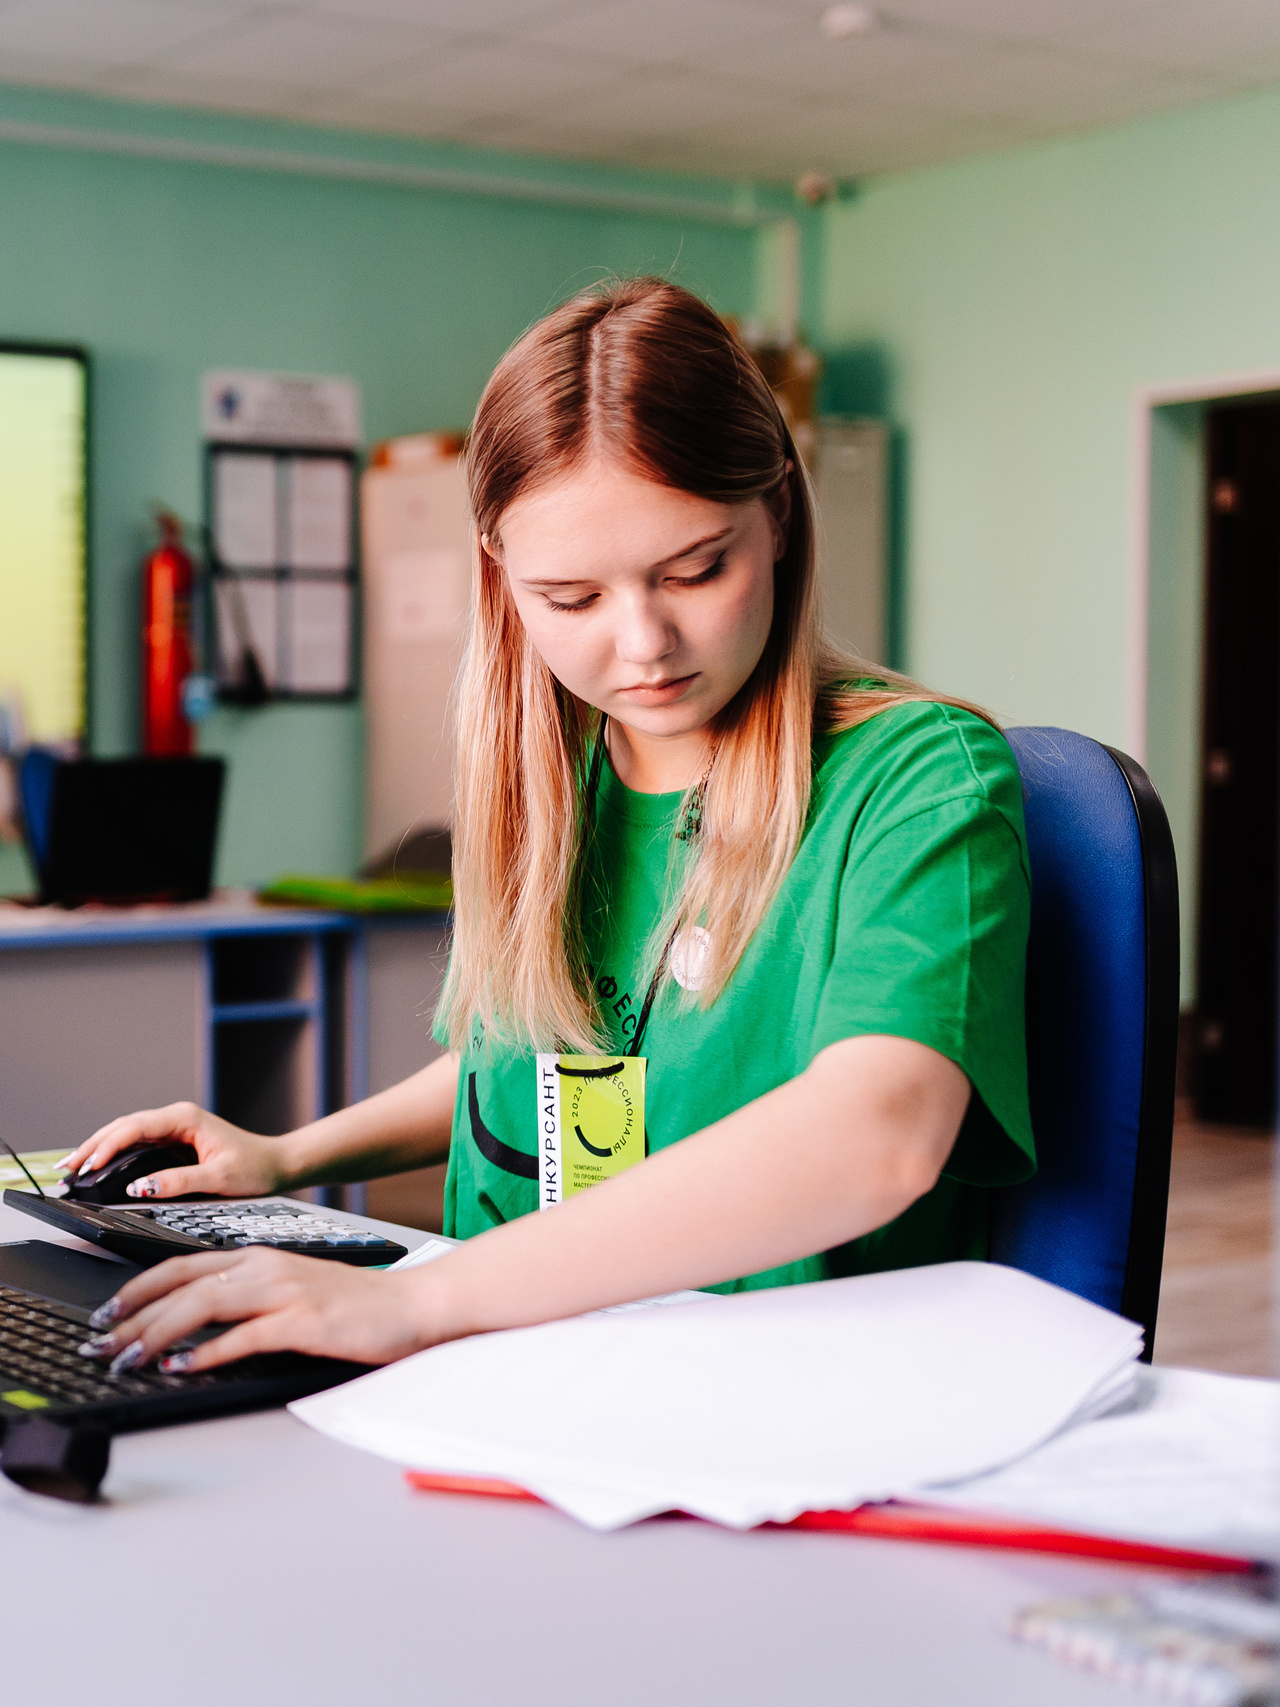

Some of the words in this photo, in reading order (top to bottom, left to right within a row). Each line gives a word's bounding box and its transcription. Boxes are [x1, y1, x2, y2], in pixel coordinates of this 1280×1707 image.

[571, 1086, 583, 1118] 2023
[543, 1068, 558, 1209] НКУРСАНТ
[573, 1164, 602, 1172] ЧЕМПИОНАТ
